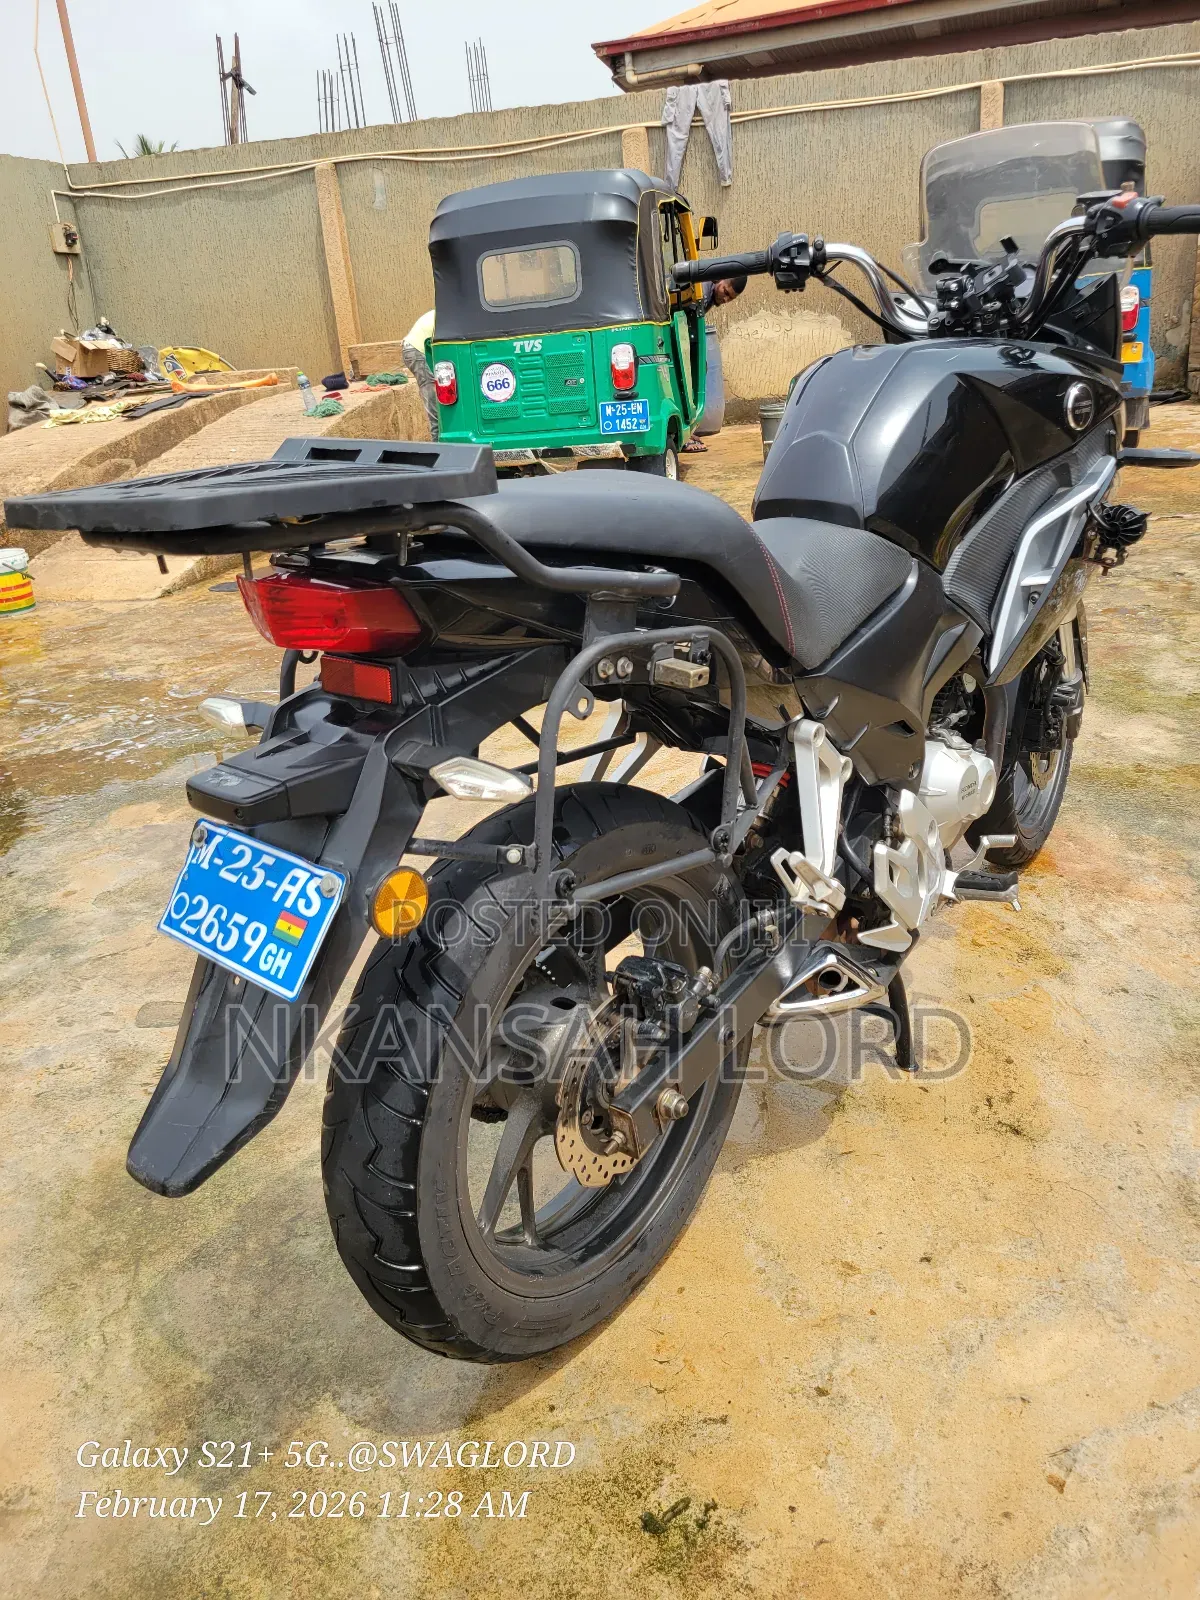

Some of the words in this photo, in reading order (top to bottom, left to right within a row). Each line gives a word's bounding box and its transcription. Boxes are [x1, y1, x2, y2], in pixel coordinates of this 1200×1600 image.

[513, 339, 543, 354] TVS
[486, 378, 511, 392] 666
[605, 402, 643, 416] M-25-EN
[615, 417, 638, 430] 1452
[192, 834, 322, 917] M-25-AS
[258, 943, 293, 979] GH
